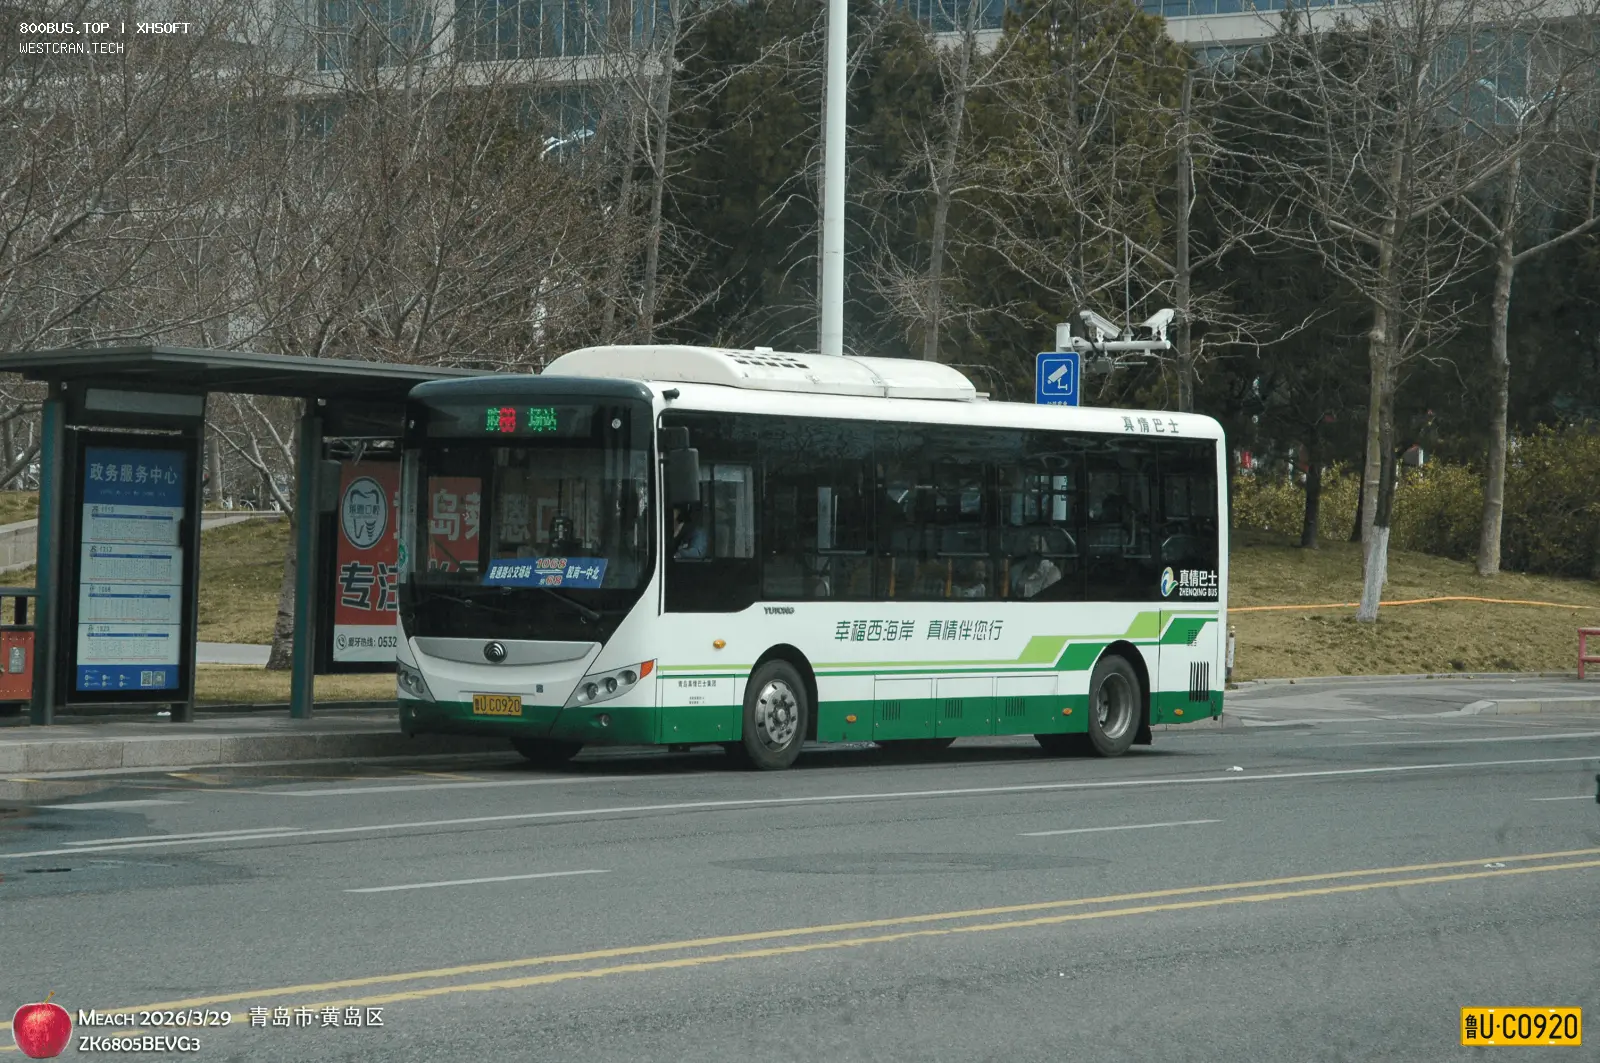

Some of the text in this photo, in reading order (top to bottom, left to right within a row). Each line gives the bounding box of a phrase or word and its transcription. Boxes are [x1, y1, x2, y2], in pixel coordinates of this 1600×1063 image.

[1121, 415, 1180, 434] 真情巴士
[89, 462, 178, 485] 政务服务中心
[535, 557, 568, 569] 1068
[1179, 569, 1218, 587] 真情巴士
[1178, 587, 1218, 597] ZHENQING BUS
[763, 606, 795, 615] YUTONG
[834, 619, 1004, 642] 幸福西海岸 真情伴您行
